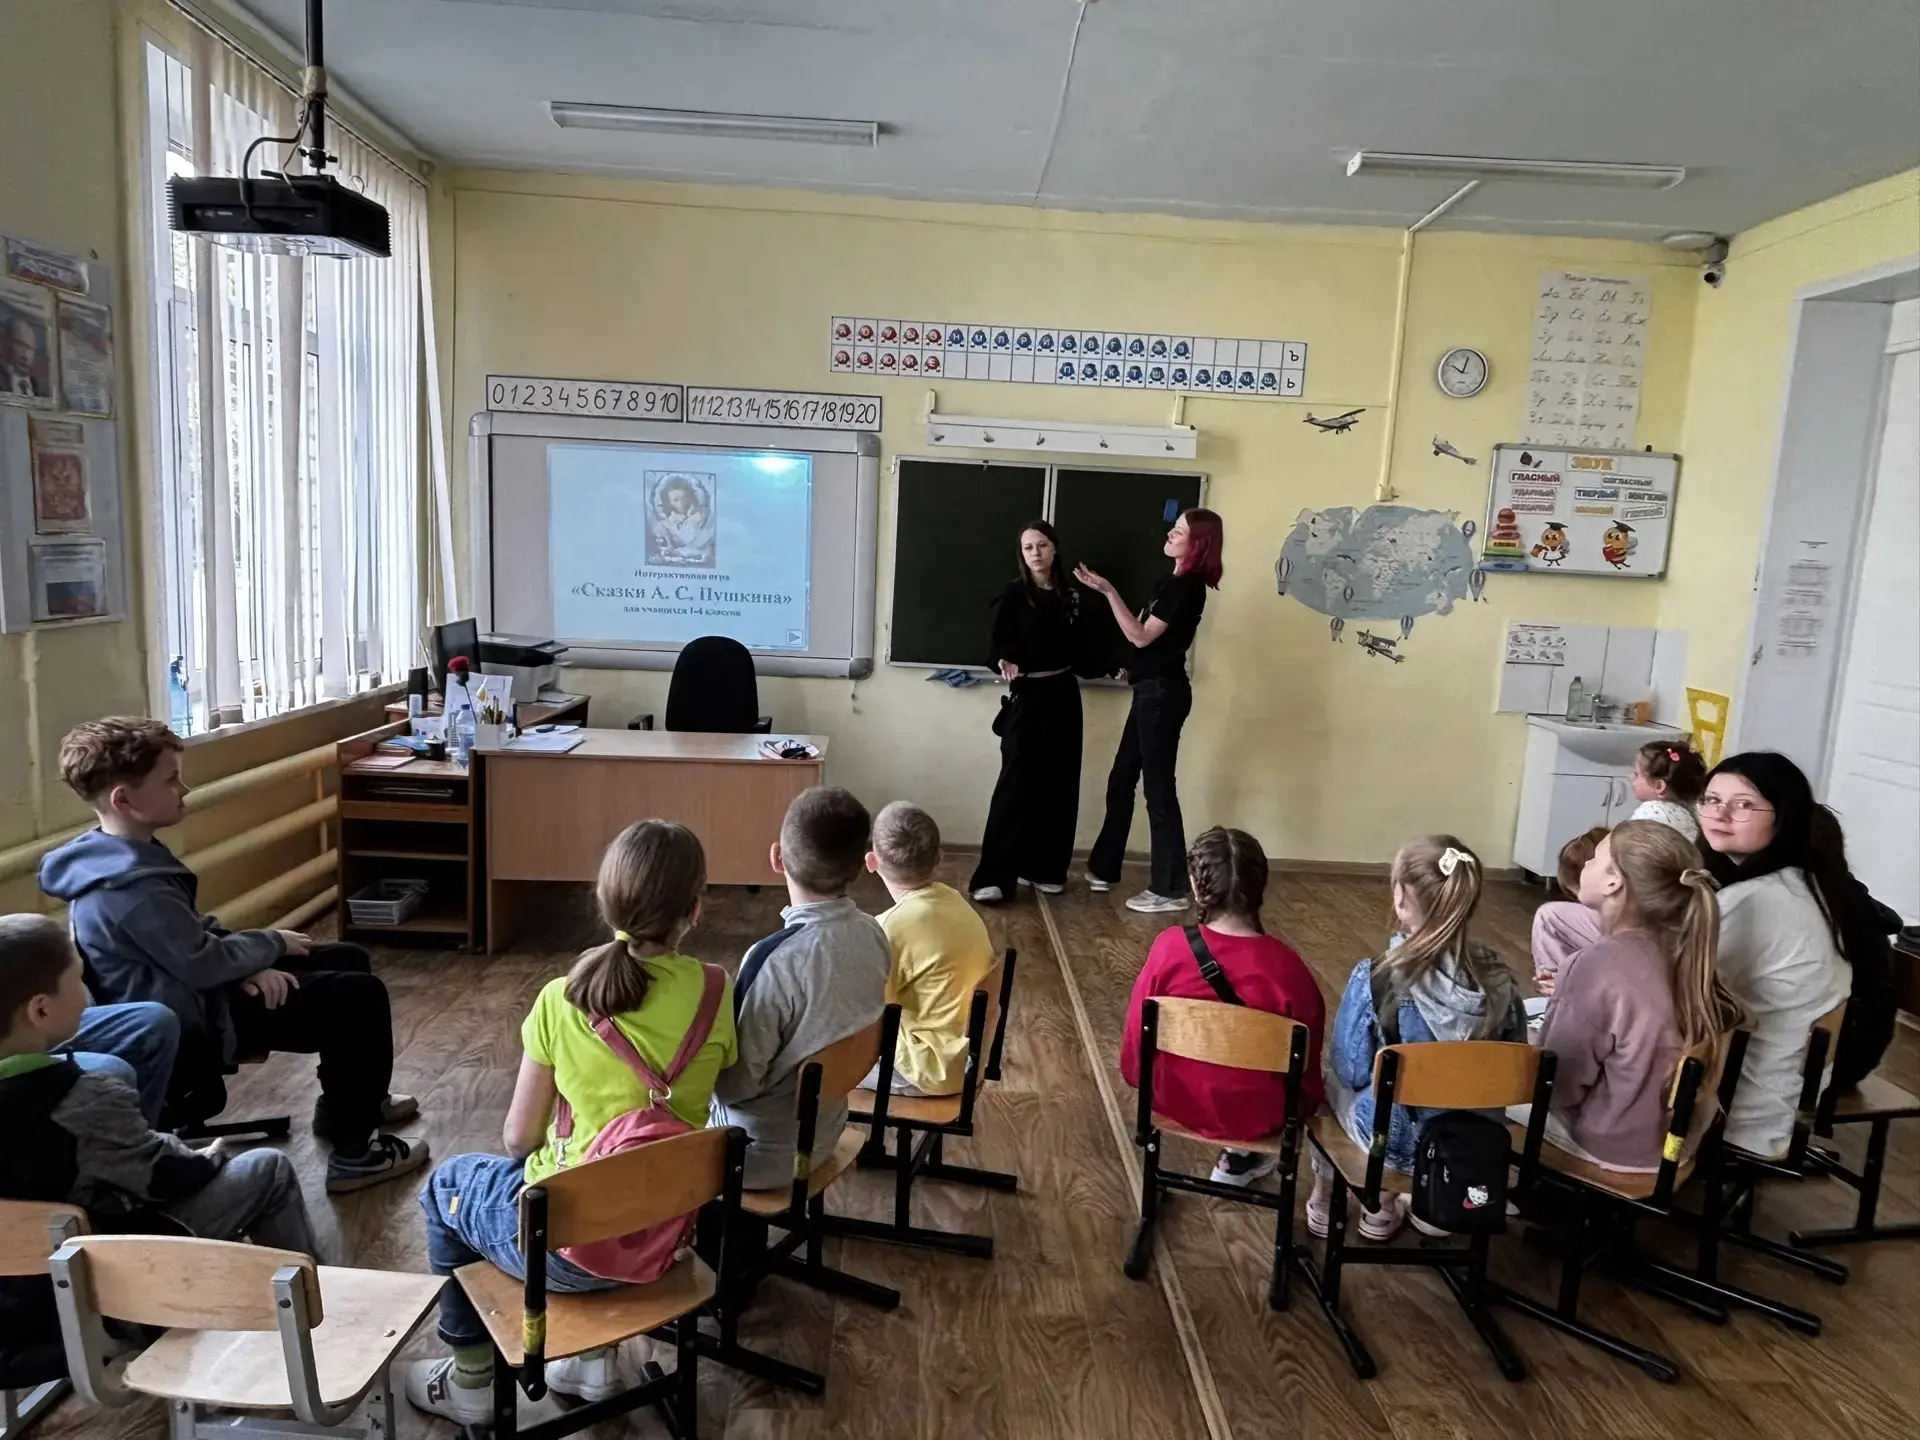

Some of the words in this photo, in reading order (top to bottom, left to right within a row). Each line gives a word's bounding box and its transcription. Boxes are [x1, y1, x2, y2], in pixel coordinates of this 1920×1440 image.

[492, 383, 505, 404] 0
[510, 384, 518, 404] 1
[522, 385, 535, 406] 2
[541, 386, 553, 407] 3
[558, 387, 570, 407] 4
[576, 388, 589, 408] 5
[593, 388, 606, 409] 6
[610, 389, 622, 410] 7
[627, 390, 640, 411] 8
[644, 391, 657, 412] 9
[659, 392, 679, 413] 10
[691, 395, 706, 416] 11
[706, 396, 724, 417] 12
[726, 397, 742, 418] 13
[745, 398, 761, 419] 14
[764, 399, 781, 420] 15
[783, 400, 799, 421] 16
[802, 400, 820, 421] 17
[821, 401, 836, 422] 18
[838, 402, 855, 423] 19
[855, 403, 877, 424] 20
[1511, 473, 1560, 482] ГЛАСНЫЙ
[708, 573, 731, 581] игра
[571, 581, 645, 598] «Сказки
[650, 585, 670, 600] А.
[675, 585, 694, 600] С.
[700, 587, 792, 604] Пушкина»
[690, 607, 703, 615] 1-4
[705, 608, 741, 617] классов
